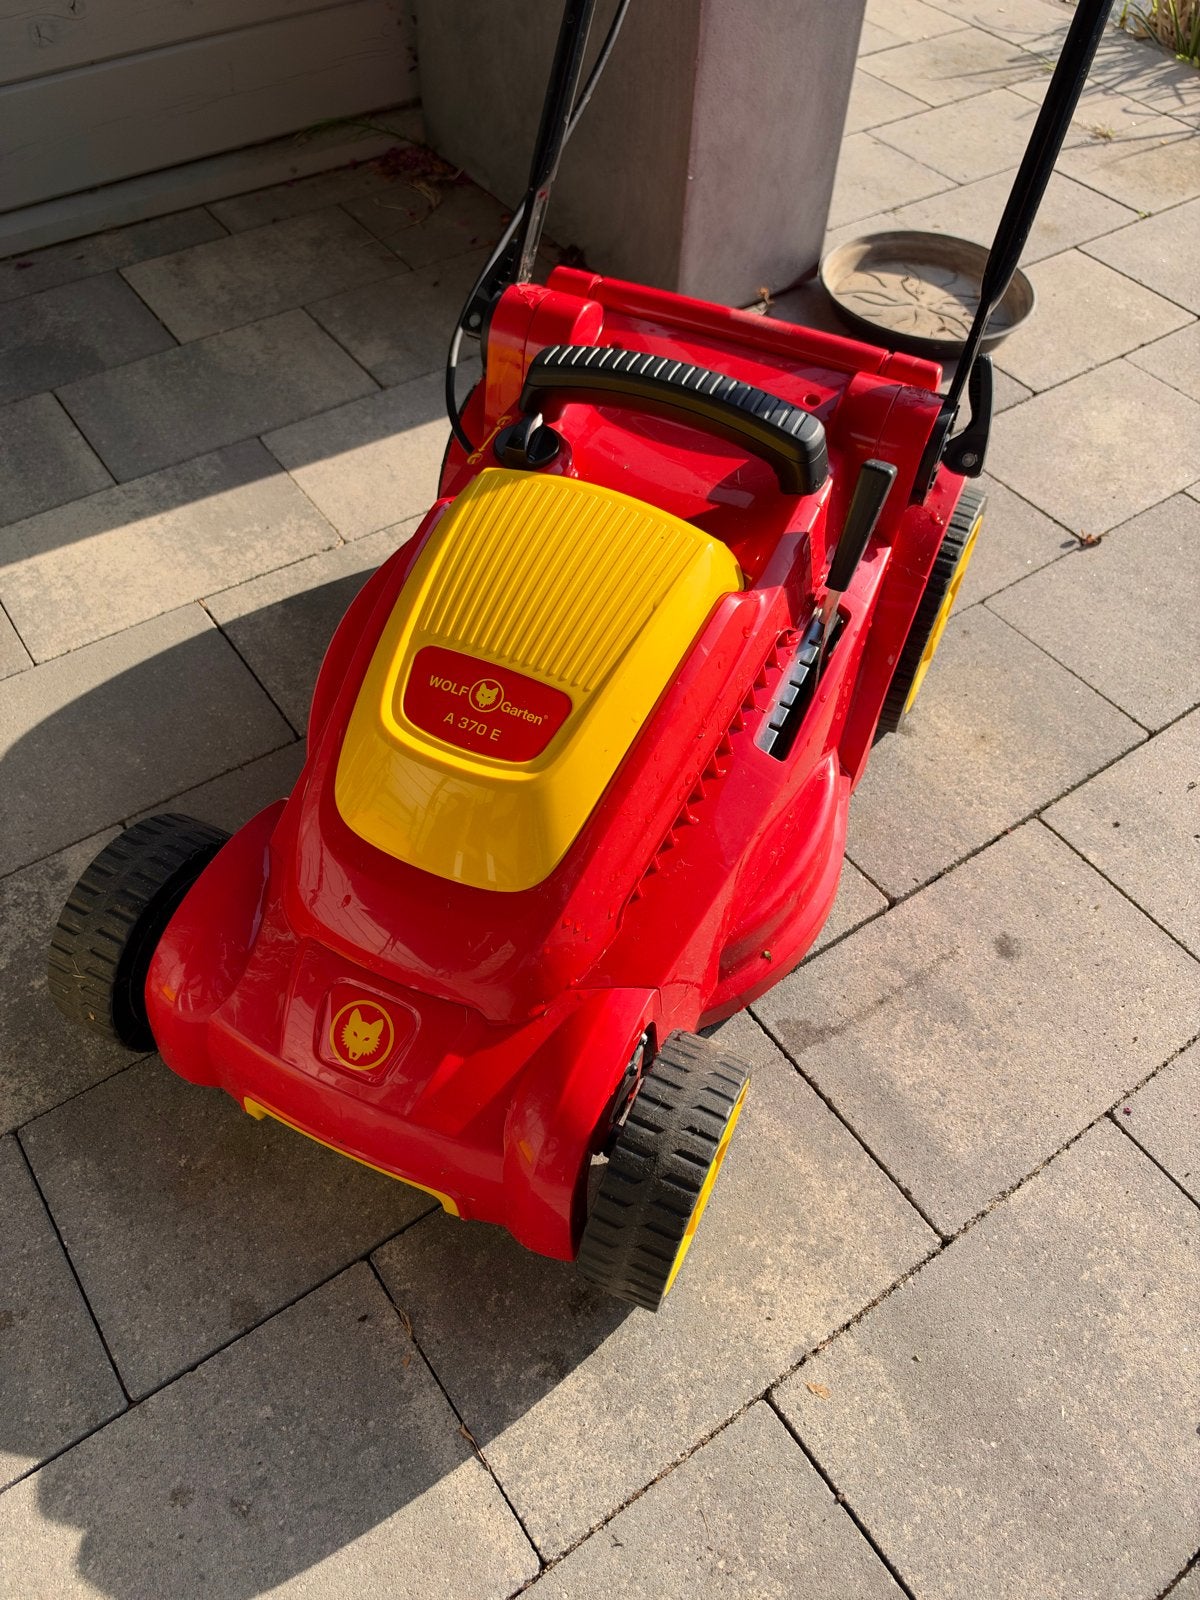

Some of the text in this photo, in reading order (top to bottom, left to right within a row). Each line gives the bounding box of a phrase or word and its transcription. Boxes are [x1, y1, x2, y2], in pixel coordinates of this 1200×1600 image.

[429, 674, 470, 697] WOLF
[443, 712, 502, 742] A 370 E
